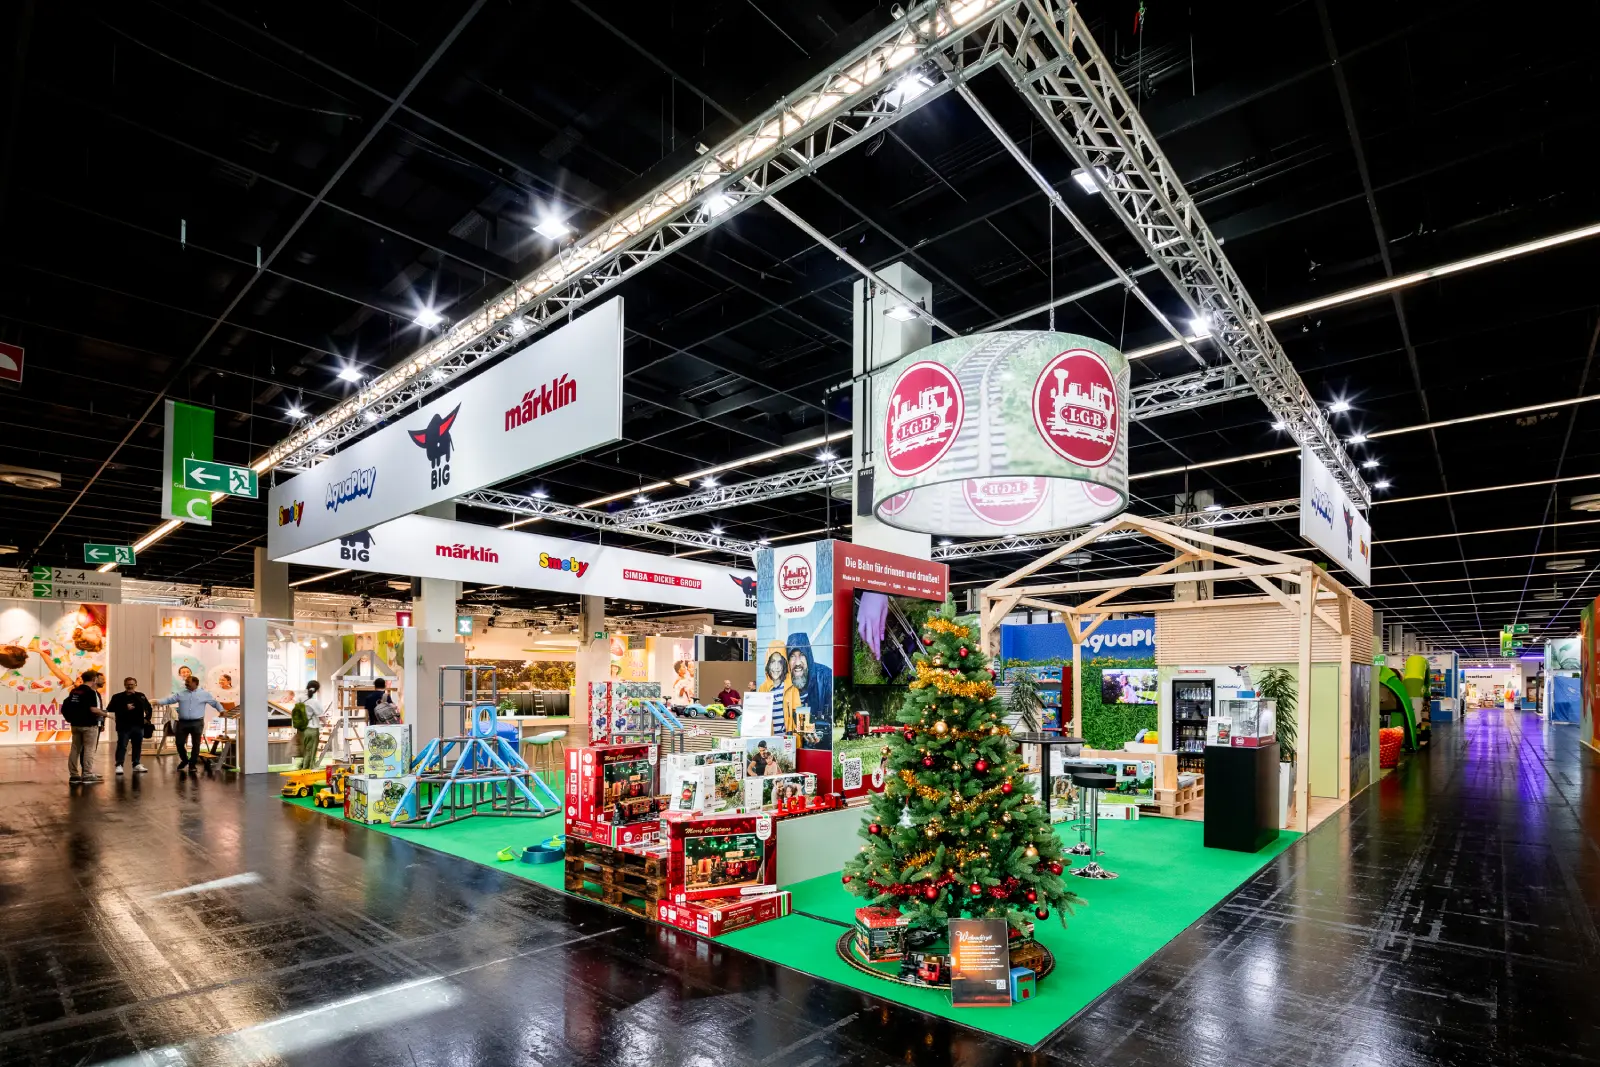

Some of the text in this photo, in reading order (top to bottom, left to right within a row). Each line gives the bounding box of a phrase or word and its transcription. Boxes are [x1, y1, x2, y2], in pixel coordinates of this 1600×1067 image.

[431, 464, 450, 490] BIG
[325, 466, 376, 512] AquaPlay
[186, 498, 208, 520] C
[279, 500, 304, 527] Smoby
[340, 548, 370, 562] BIG
[539, 552, 589, 578] Smoby
[54, 569, 62, 579] 2
[77, 572, 85, 580] 4
[624, 570, 701, 588] SIMBA DICKIE GROUP
[845, 557, 940, 584] Die Bahn für drinnen und draußen!
[162, 617, 216, 630] HELLO
[19, 719, 71, 732] HERE
[704, 826, 732, 834] Christmas
